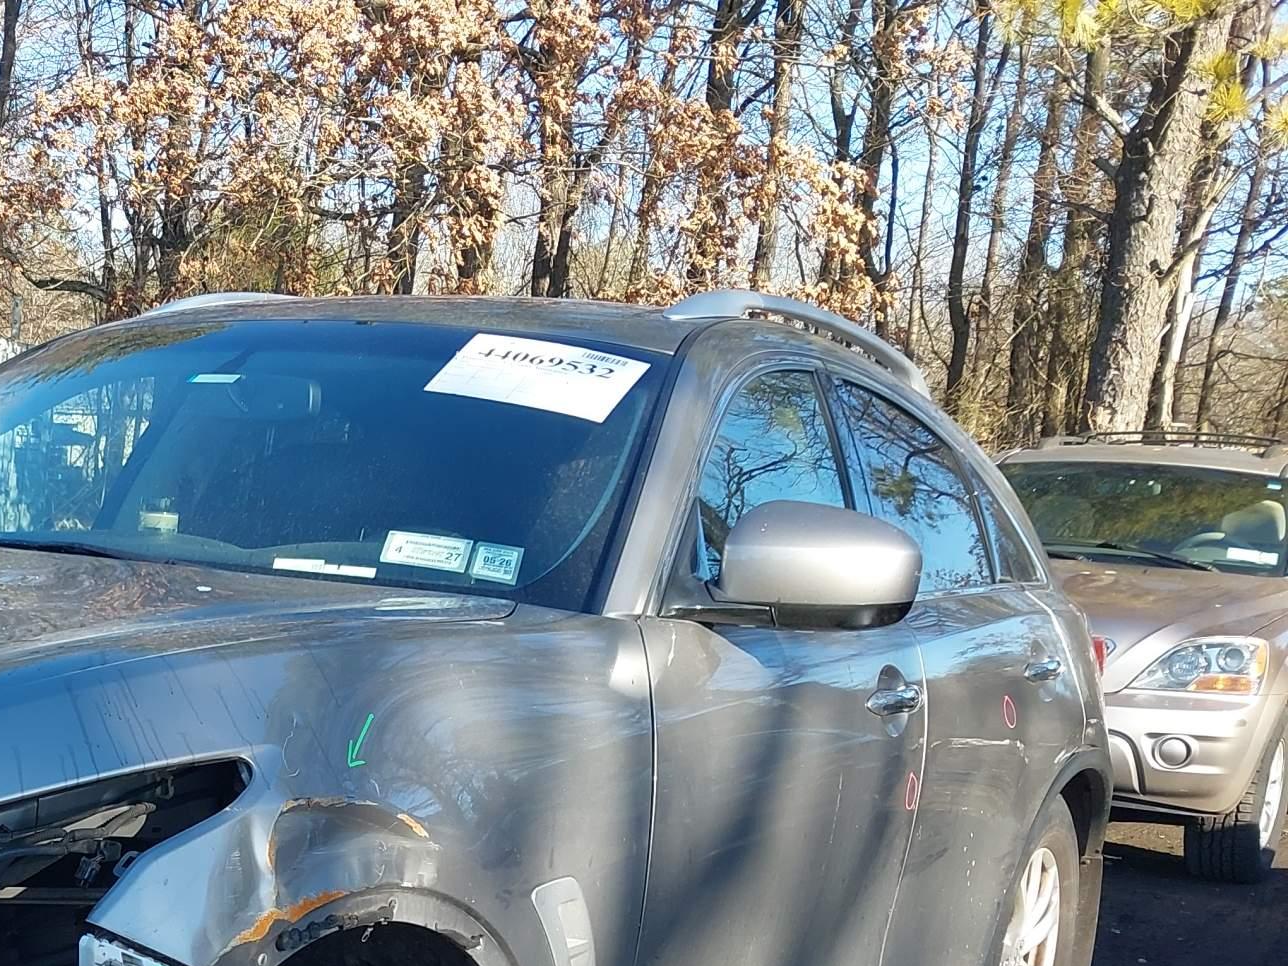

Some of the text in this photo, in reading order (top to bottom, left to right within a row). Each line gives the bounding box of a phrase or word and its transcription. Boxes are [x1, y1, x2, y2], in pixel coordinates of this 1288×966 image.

[478, 348, 616, 379] 44069532
[394, 545, 403, 554] 4
[444, 552, 463, 562] 27
